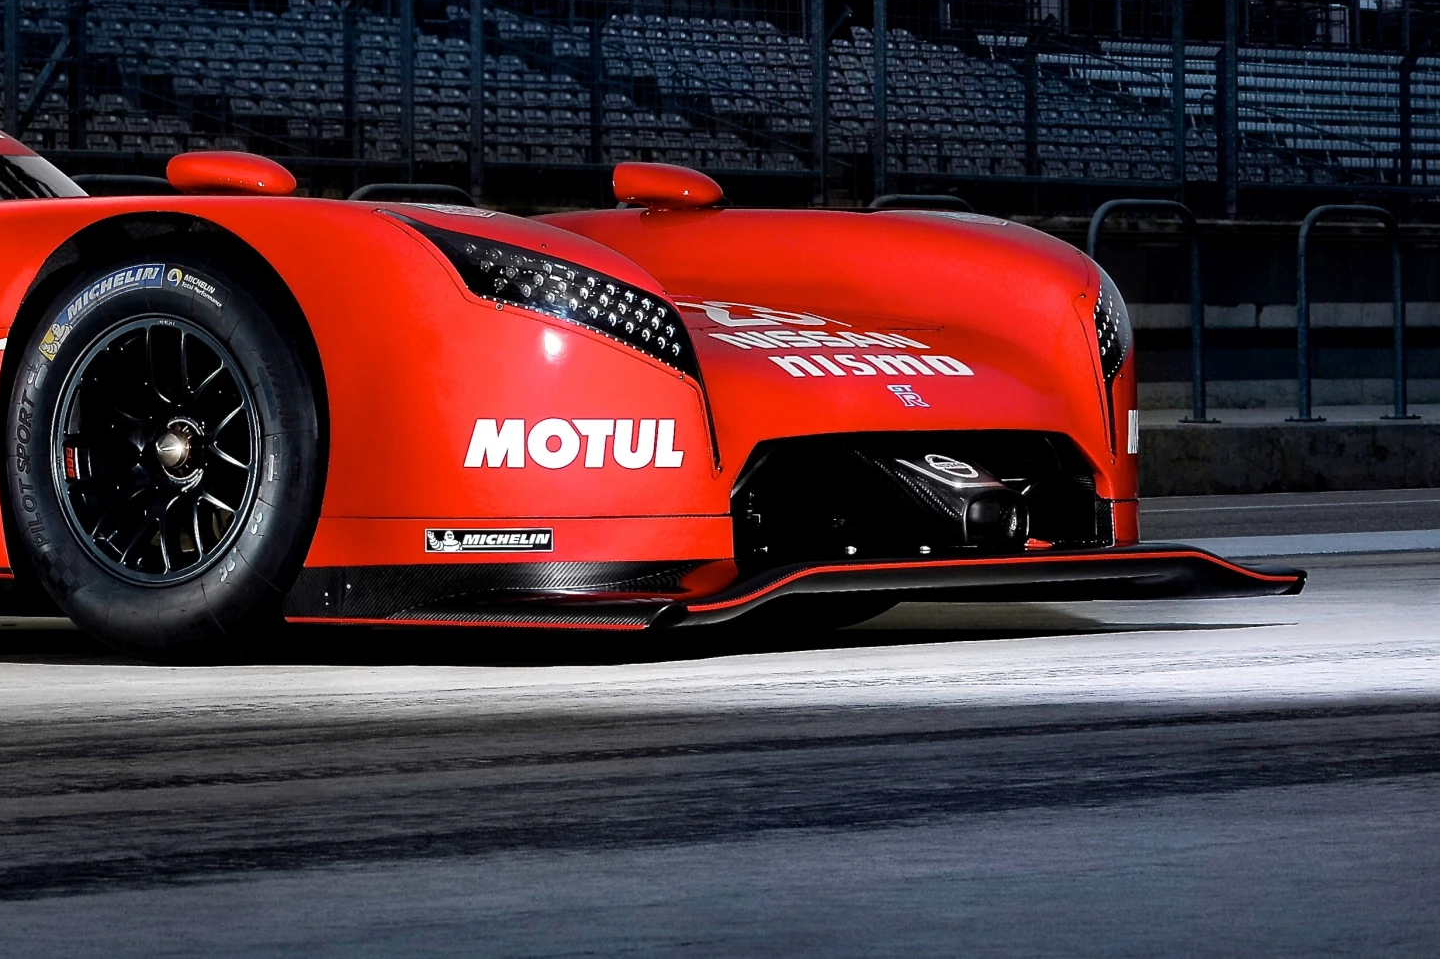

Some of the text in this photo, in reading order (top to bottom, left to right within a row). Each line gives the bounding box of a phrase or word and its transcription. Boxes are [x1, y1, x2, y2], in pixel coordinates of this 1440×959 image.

[67, 266, 161, 321] MICHELIN
[181, 281, 195, 291] Total
[183, 274, 216, 294] MICHELIN
[709, 330, 931, 349] NISSAN
[768, 354, 975, 377] nismo
[886, 384, 912, 393] GT
[893, 392, 931, 407] R
[16, 390, 36, 474] SPORT
[463, 416, 685, 470] MOTUL
[17, 479, 51, 547] PILOT
[462, 533, 550, 545] MICHELIN
